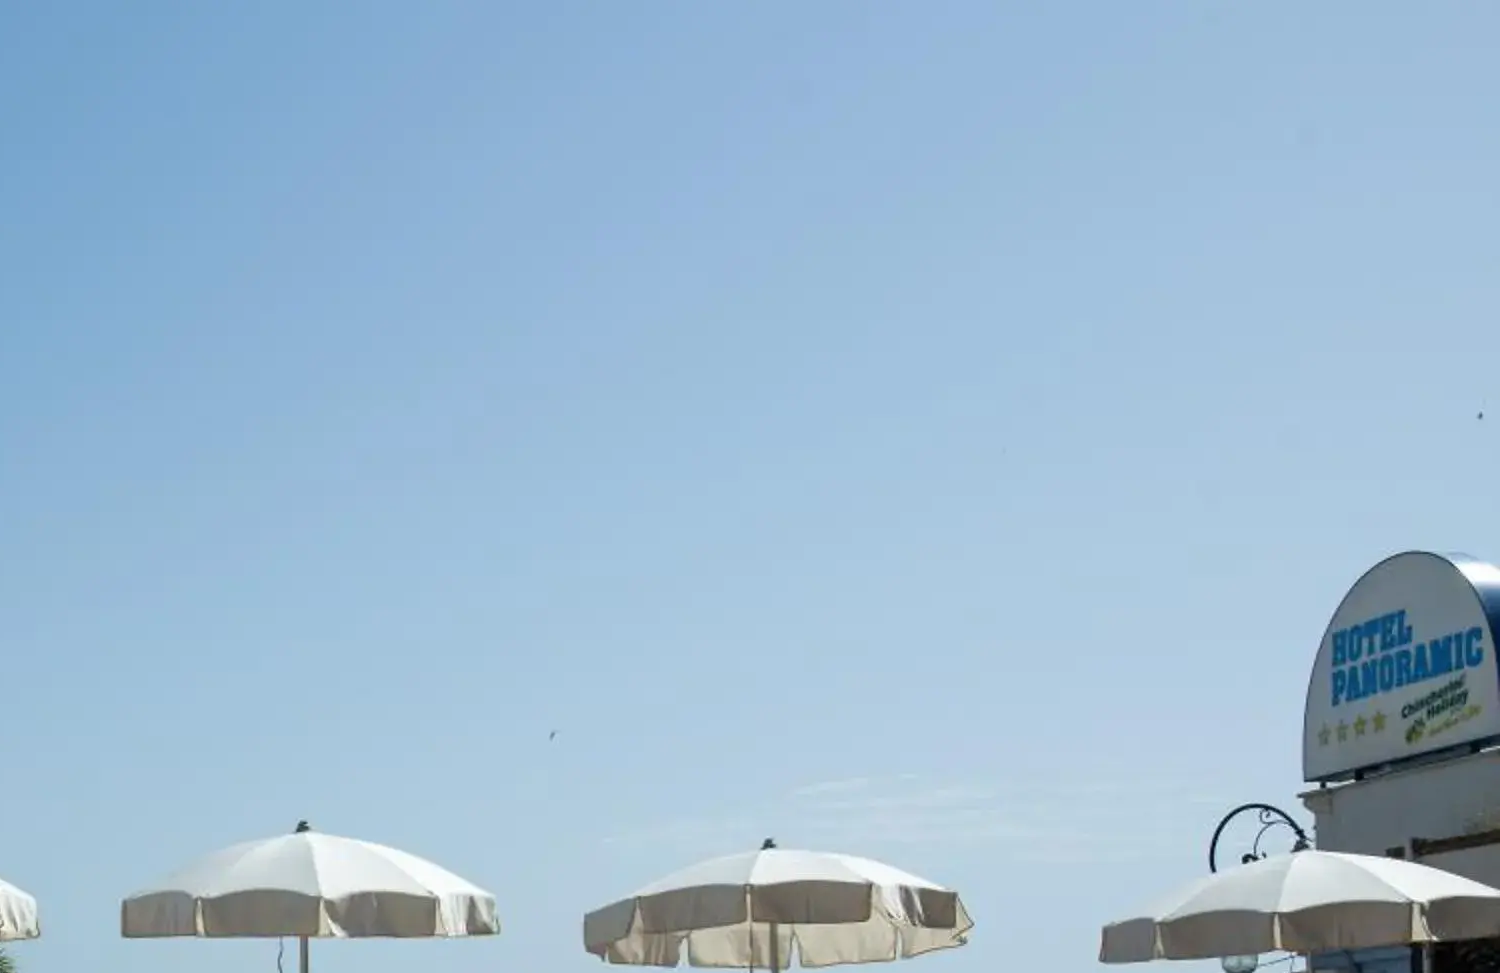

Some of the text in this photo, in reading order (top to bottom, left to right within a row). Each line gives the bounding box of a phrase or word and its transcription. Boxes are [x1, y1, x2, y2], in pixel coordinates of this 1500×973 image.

[1332, 609, 1412, 667] HOTEL
[1332, 626, 1483, 707] PANORAMIC
[1427, 688, 1469, 720] Holiday
